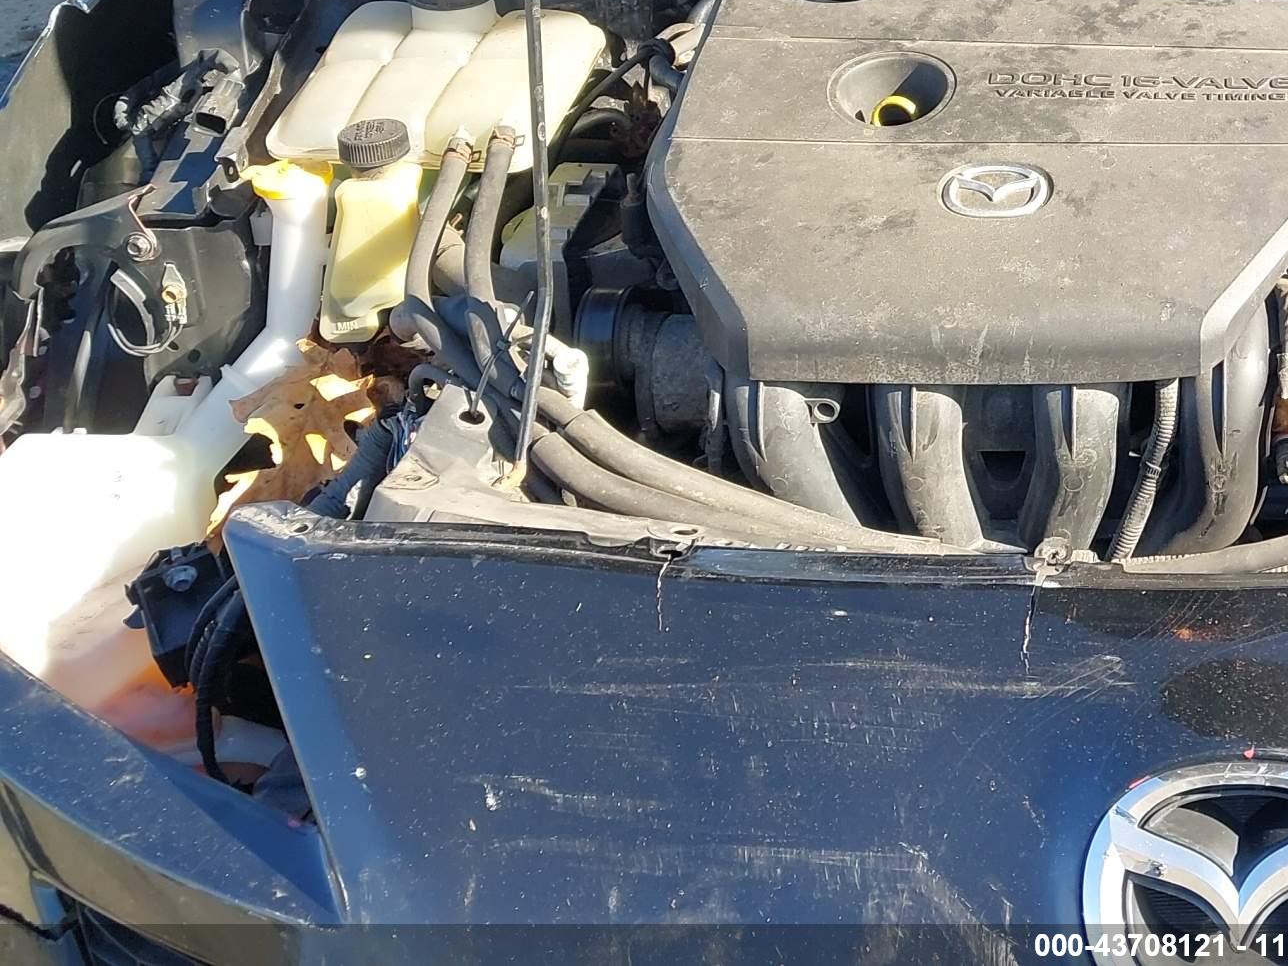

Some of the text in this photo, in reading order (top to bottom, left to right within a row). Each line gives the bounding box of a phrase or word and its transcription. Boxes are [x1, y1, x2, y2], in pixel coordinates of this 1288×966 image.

[988, 72, 1114, 87] DOHC
[995, 89, 1288, 102] VARIABLE VALVE TIMING
